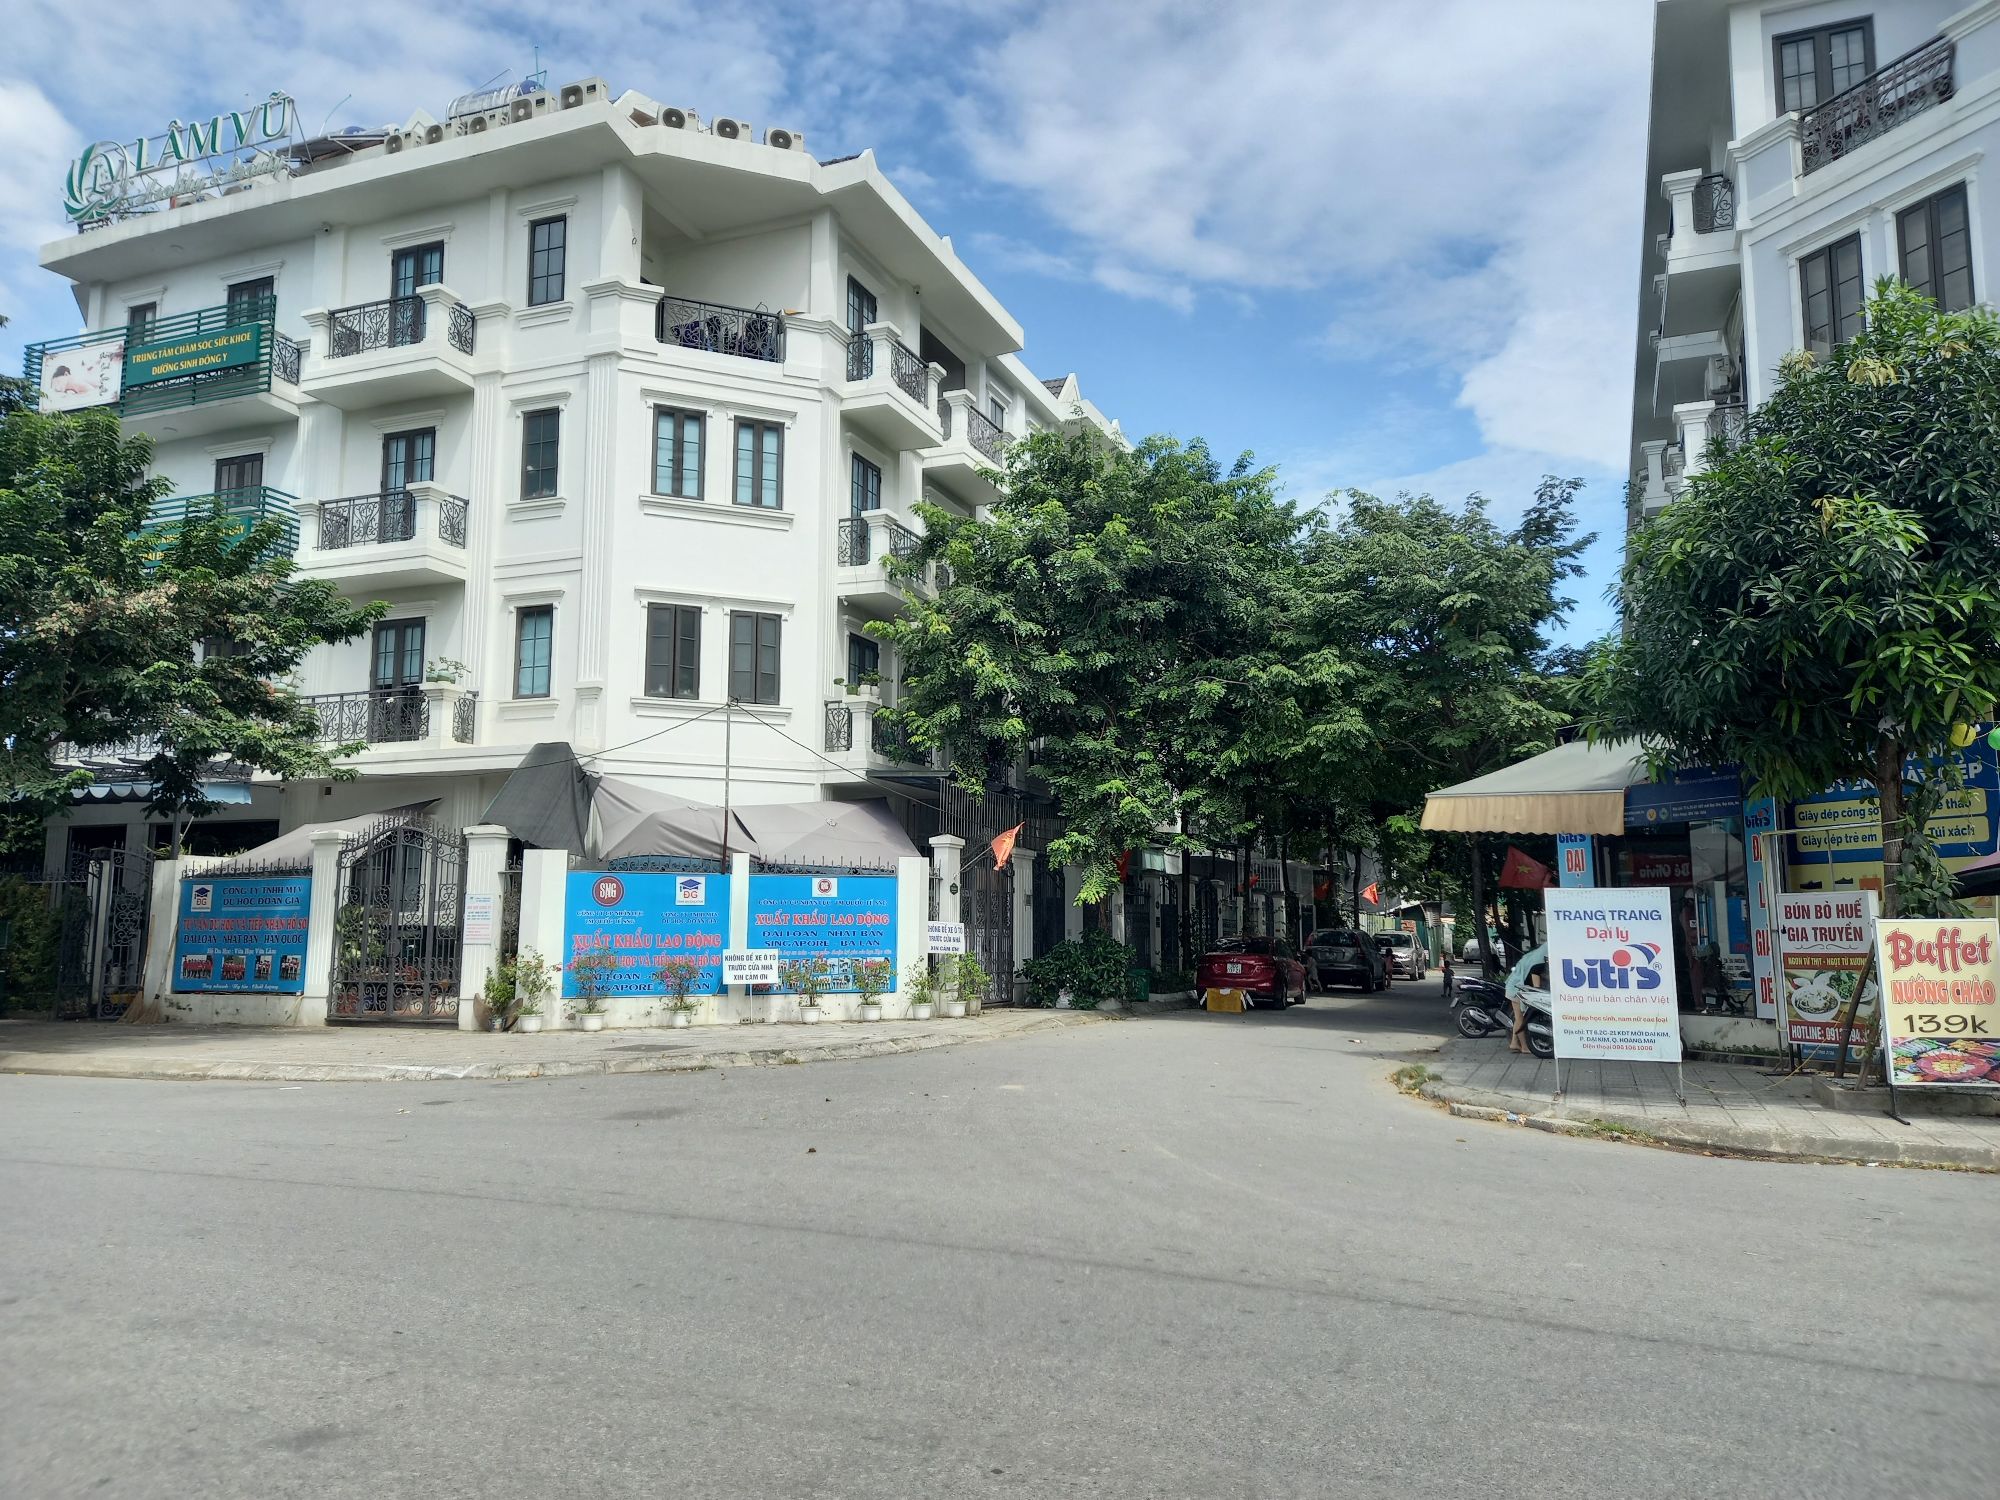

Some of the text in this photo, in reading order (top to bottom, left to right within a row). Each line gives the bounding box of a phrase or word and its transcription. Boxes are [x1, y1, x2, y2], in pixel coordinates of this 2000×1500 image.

[136, 89, 293, 172] LÂM VŨ
[132, 351, 158, 364] TRUNG
[157, 347, 175, 359] TÂM
[179, 358, 198, 370] SINH
[1798, 811, 1818, 823] Giày
[1820, 806, 1839, 821] dép
[1841, 807, 1866, 820] công
[1928, 825, 1945, 838] Túi
[1801, 835, 1822, 847] Giày
[1861, 834, 1877, 843] em
[262, 886, 284, 894] TNHH
[683, 890, 698, 899] ĐG
[1554, 910, 1661, 921] TRANG TRANG
[1784, 897, 1862, 919] BÚN BÒ HUẾ
[755, 908, 889, 928] XUẤT KHẨU LAO ĐỘNG
[572, 927, 722, 951] XUẤT KHẨU LAO ĐỘNG
[786, 930, 818, 938] LOAN
[1787, 926, 1809, 941] GIA
[1812, 922, 1863, 941] TRUYỀN
[764, 940, 829, 948] SINGAPORE
[1885, 927, 1992, 973] Buffet
[724, 953, 744, 962] KHÔNG
[1891, 973, 1949, 1005] NƯỚNG
[1651, 995, 1669, 1005] Việt
[1904, 1014, 1988, 1034] 139k
[1791, 1025, 1825, 1040] HOTLINE:
